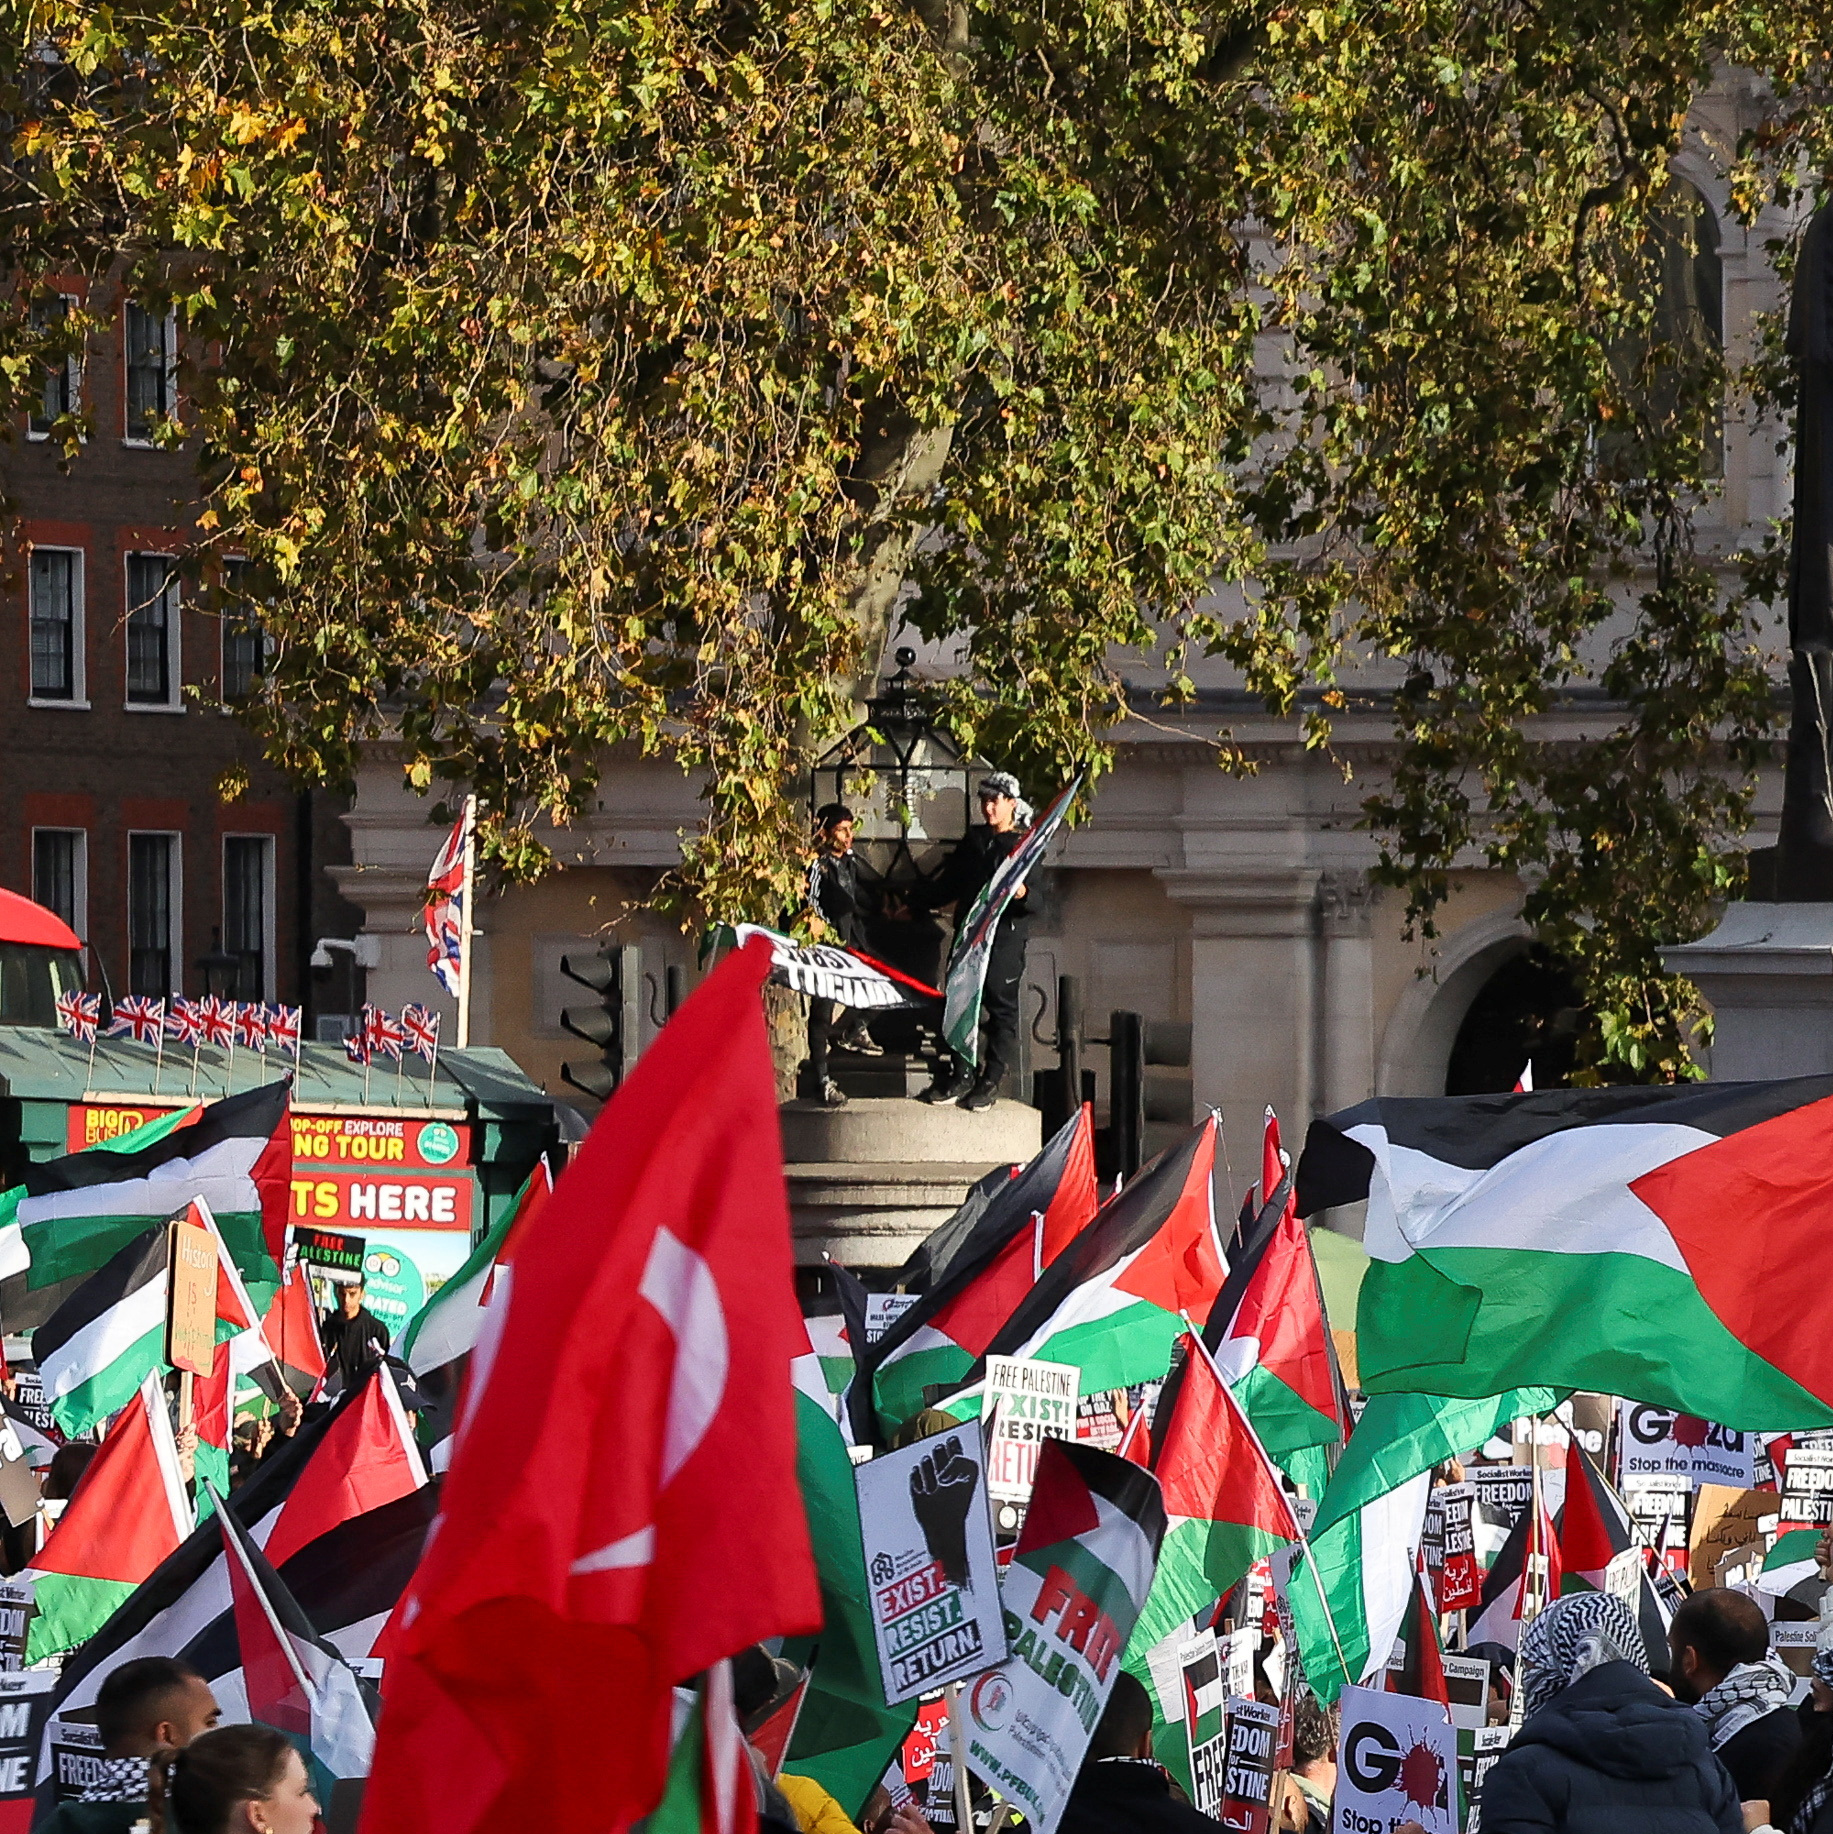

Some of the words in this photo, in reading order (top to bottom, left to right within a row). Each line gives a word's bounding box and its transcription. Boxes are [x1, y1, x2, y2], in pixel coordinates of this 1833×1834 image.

[86, 1109, 117, 1129] BIG
[290, 1119, 342, 1135] OP-OFF
[345, 1120, 404, 1137] EXPLORE
[336, 1134, 405, 1161] TOUR
[349, 1183, 456, 1222] HERE
[993, 1363, 1018, 1388] FREE
[1022, 1367, 1072, 1397] PALESTINE
[1629, 1457, 1654, 1473] Stop
[1665, 1457, 1687, 1471] the
[1692, 1458, 1745, 1478] massacre
[878, 1566, 947, 1613] EXIST.
[883, 1598, 961, 1659] RESIST.
[891, 1625, 981, 1688] RETURN.
[1448, 1661, 1485, 1677] Campaign
